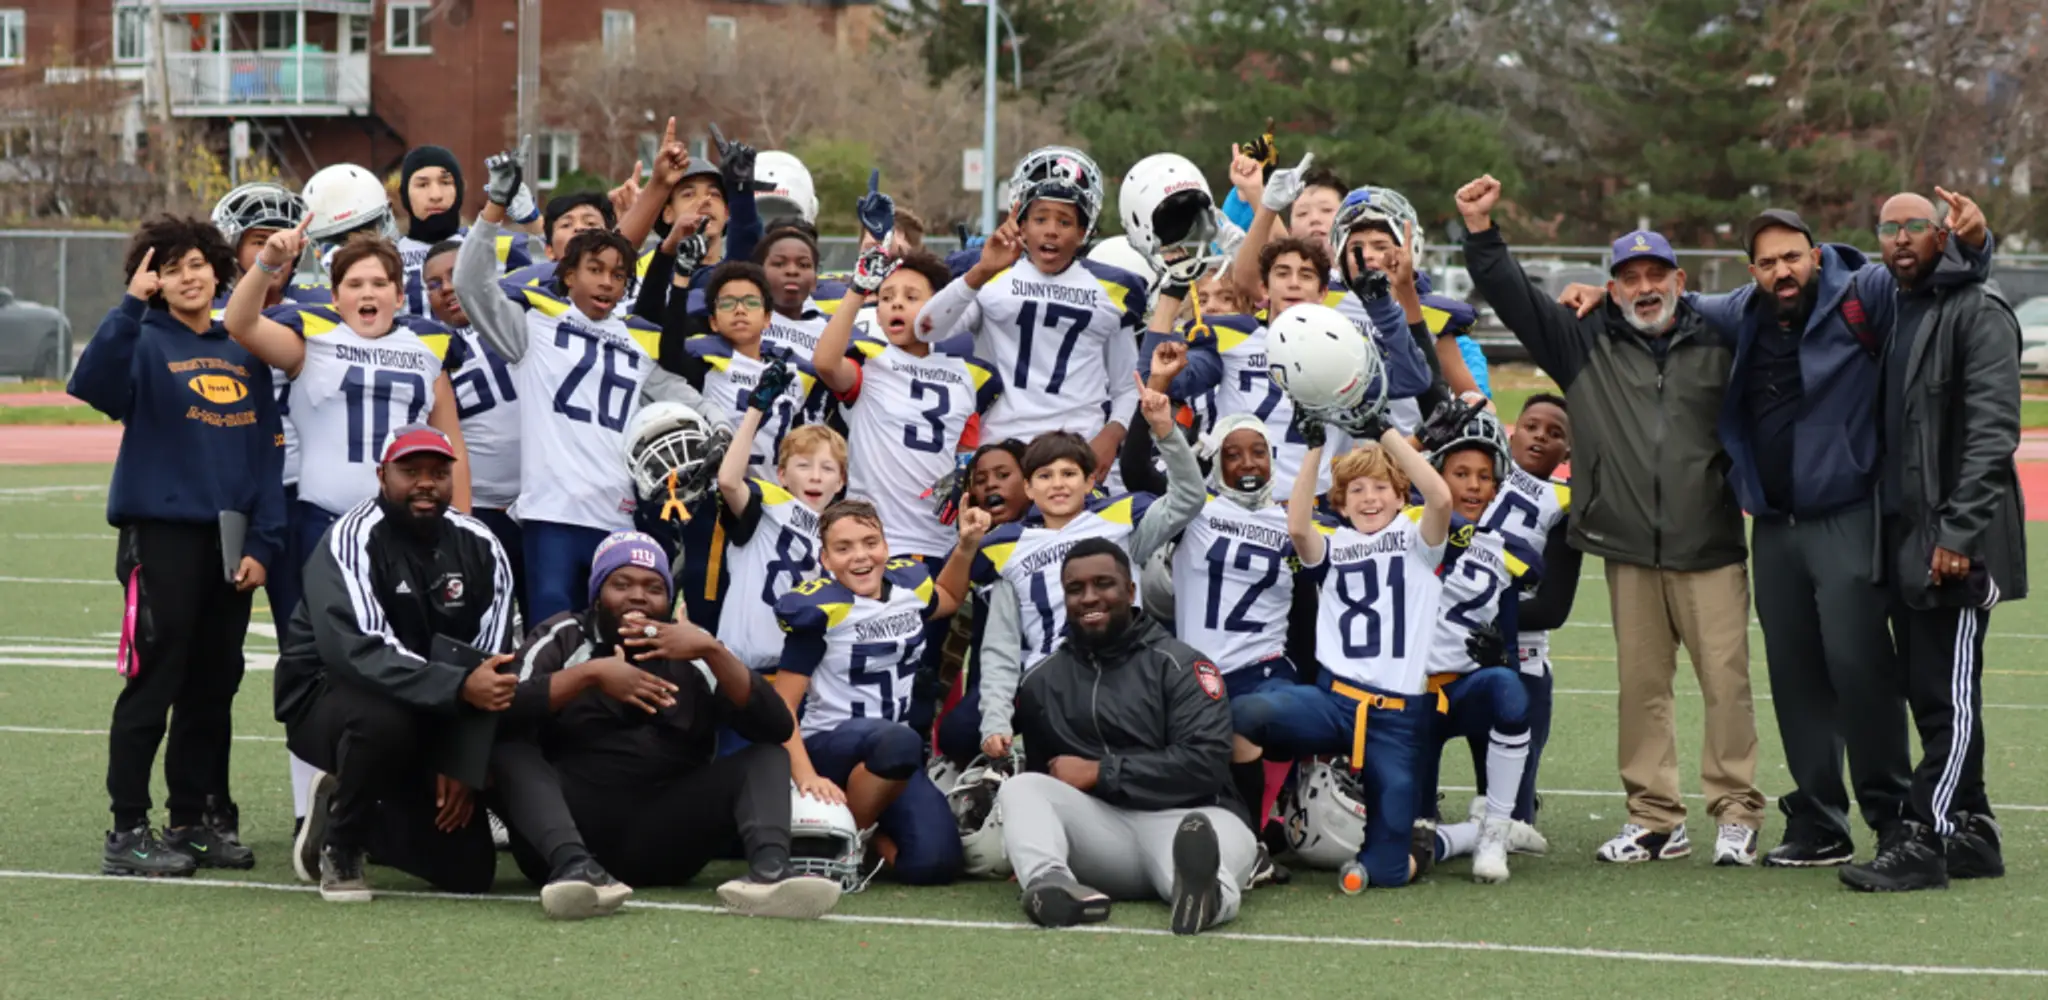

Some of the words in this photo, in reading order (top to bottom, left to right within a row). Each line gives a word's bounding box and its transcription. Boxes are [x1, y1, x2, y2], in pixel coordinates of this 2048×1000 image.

[1011, 278, 1099, 308] SUNNYBROOKE
[335, 344, 426, 371] SUNNYBROOKE
[553, 322, 640, 433] 26
[1013, 300, 1093, 394] 17
[339, 365, 426, 463] 10
[903, 378, 951, 454] 3
[1204, 535, 1283, 633] 12
[1334, 556, 1406, 659] 81
